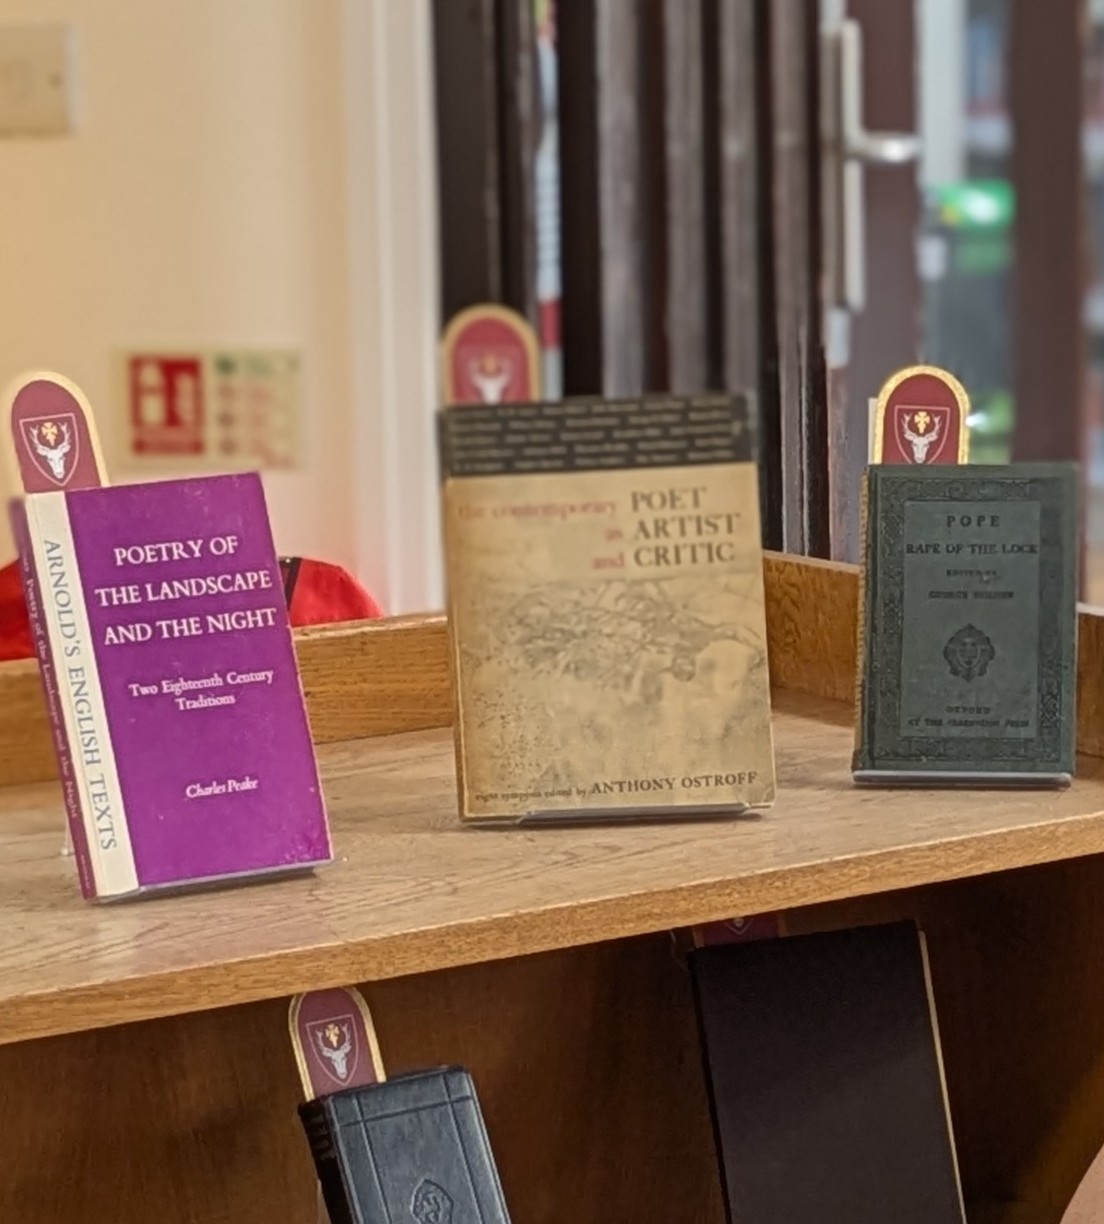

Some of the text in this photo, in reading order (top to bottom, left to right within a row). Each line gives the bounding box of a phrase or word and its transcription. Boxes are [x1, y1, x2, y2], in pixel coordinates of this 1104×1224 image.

[630, 486, 706, 512] POET
[634, 512, 740, 542] ARTIST
[946, 515, 1000, 528] POPE
[114, 536, 238, 566] POETRY OF
[592, 542, 735, 570] and CRITIC
[906, 544, 1038, 554] RAPE OF THE LOCK
[94, 570, 272, 606] THE LANDSCAPE
[104, 608, 277, 645] AND THE NIGHT
[42, 538, 117, 850] ARNOLD'S ENGLISH TEXTS
[128, 670, 274, 696] Two Eighteenth Century
[175, 694, 236, 710] Traditions
[186, 776, 258, 798] Charles Peake
[576, 786, 588, 798] by
[591, 777, 676, 796] ANTHONY
[680, 771, 758, 789] OSTROFF
